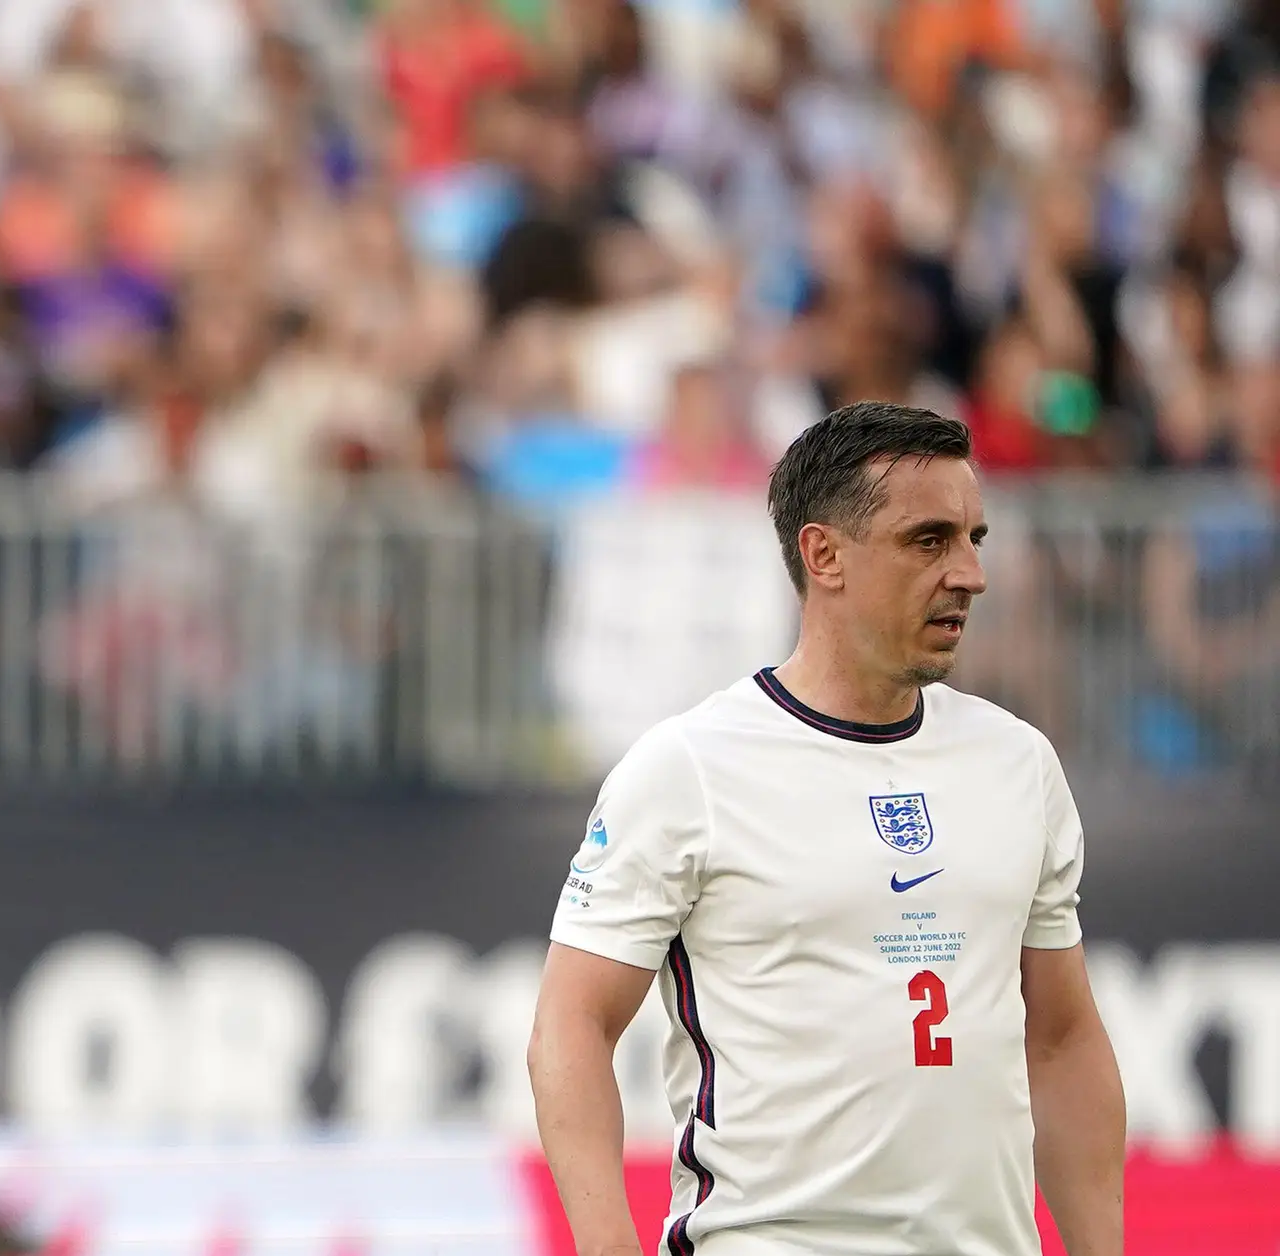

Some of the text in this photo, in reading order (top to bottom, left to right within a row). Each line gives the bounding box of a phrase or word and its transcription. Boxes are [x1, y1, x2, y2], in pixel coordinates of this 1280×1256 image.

[579, 881, 593, 894] AID
[901, 912, 936, 920] ENGLAND
[873, 934, 904, 943] SOCCER
[905, 934, 918, 942] AID
[920, 933, 947, 941] WORLD
[948, 932, 956, 940] XI
[880, 943, 962, 953] SUNDAY 12 JUNE 2022
[888, 954, 956, 964] LONDON STADIUM
[908, 970, 952, 1066] 2
